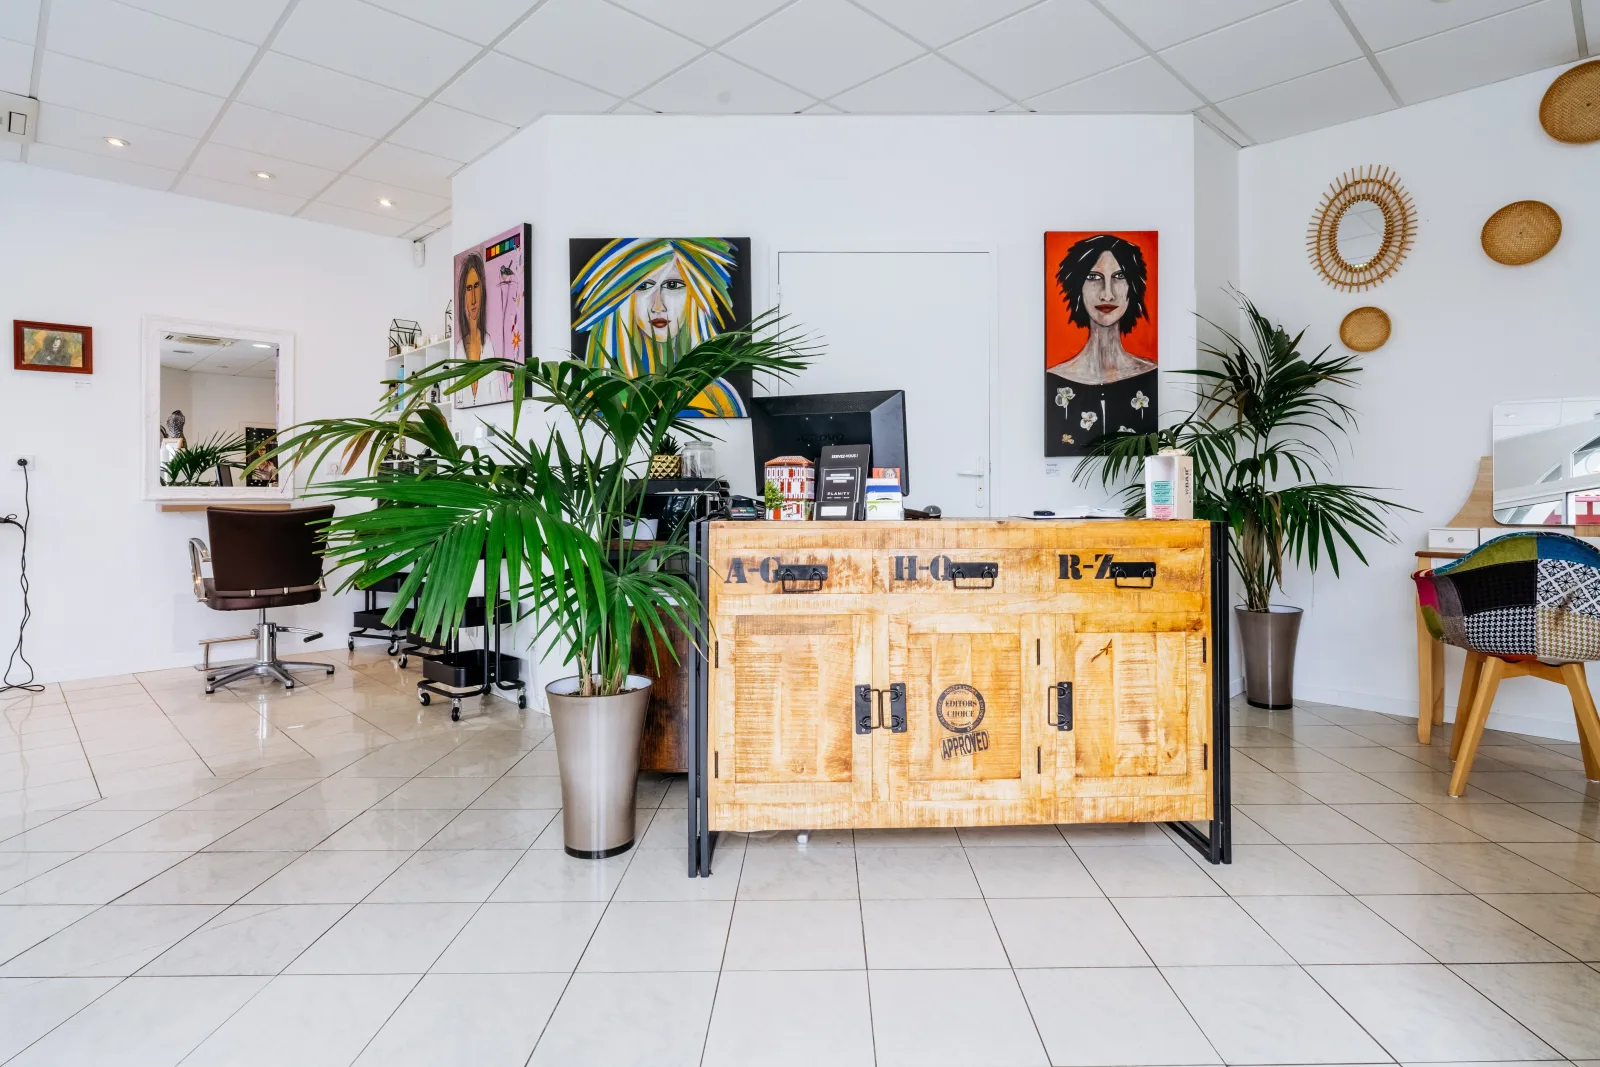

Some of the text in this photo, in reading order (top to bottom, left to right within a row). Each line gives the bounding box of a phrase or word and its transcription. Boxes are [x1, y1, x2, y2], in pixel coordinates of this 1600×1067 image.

[723, 556, 780, 584] A-G
[1058, 553, 1114, 580] R-Z
[945, 700, 977, 708] EDITORS
[947, 710, 975, 718] CHOICE
[942, 731, 989, 760] APPROVED
